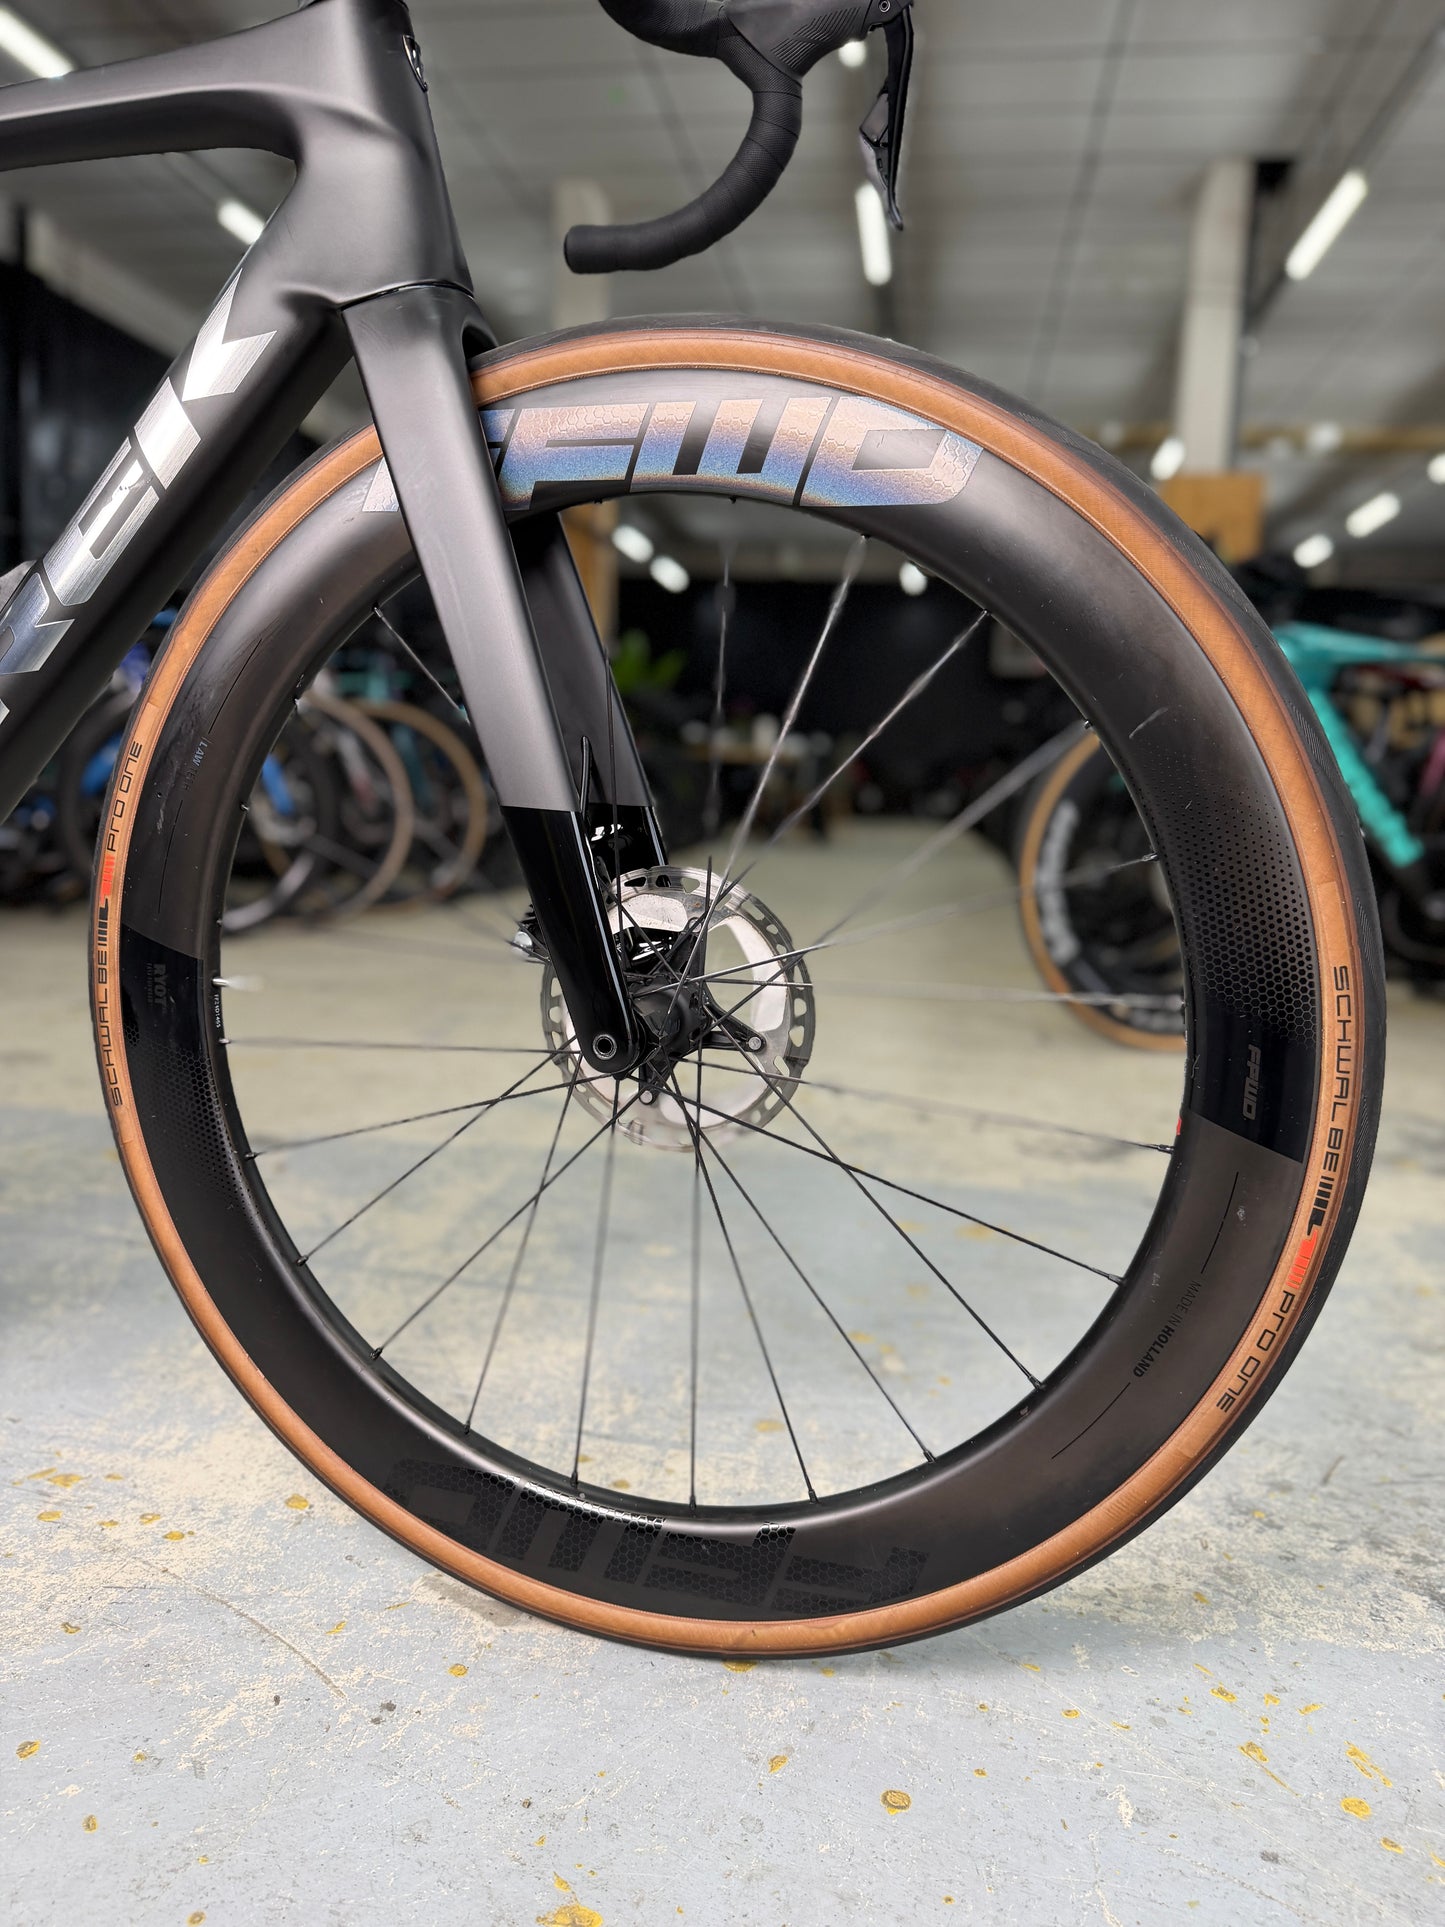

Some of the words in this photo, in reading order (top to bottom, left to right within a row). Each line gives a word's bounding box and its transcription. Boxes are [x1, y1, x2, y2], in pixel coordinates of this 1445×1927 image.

[97, 950, 123, 1106] SCHWALBE
[1243, 1043, 1262, 1121] FFWD
[1322, 965, 1351, 1173] SCHWALBE
[1168, 1312, 1183, 1328] IN
[1176, 1280, 1202, 1314] MADE
[1133, 1325, 1176, 1378] HOLLAND
